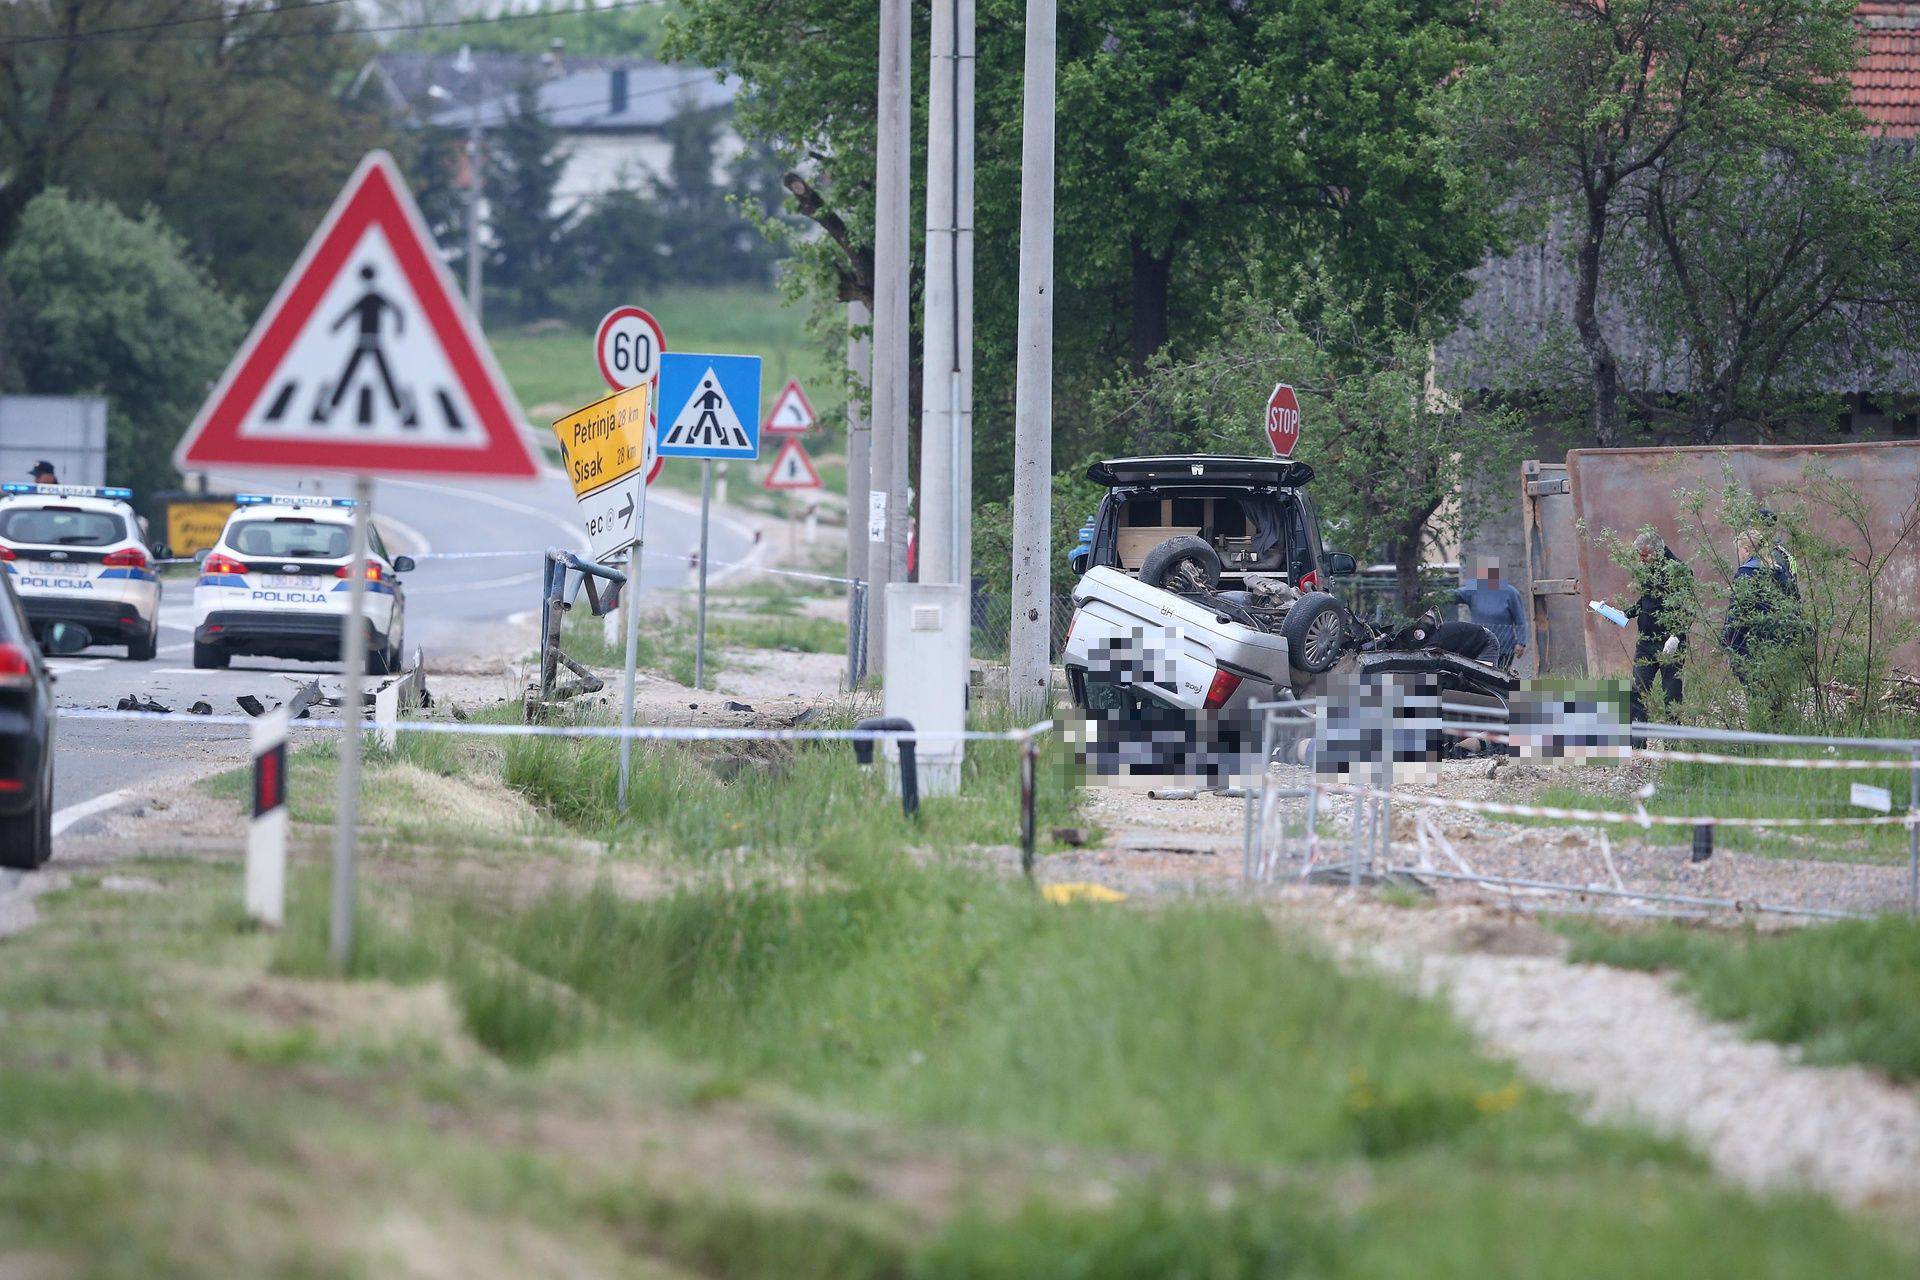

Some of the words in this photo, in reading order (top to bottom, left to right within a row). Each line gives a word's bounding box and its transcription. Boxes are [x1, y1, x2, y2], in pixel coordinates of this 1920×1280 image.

[614, 332, 650, 373] 60
[573, 410, 615, 447] Petrinja
[617, 408, 627, 428] 28
[628, 406, 639, 422] km
[1270, 406, 1298, 435] STOP
[574, 451, 603, 484] Sisak
[617, 446, 625, 466] 28
[626, 444, 637, 460] km
[39, 485, 93, 496] POLICIJA
[274, 497, 329, 506] POLICIJA
[20, 577, 94, 590] POLICIJA
[252, 591, 327, 604] POLICIJA
[1160, 604, 1175, 618] HR
